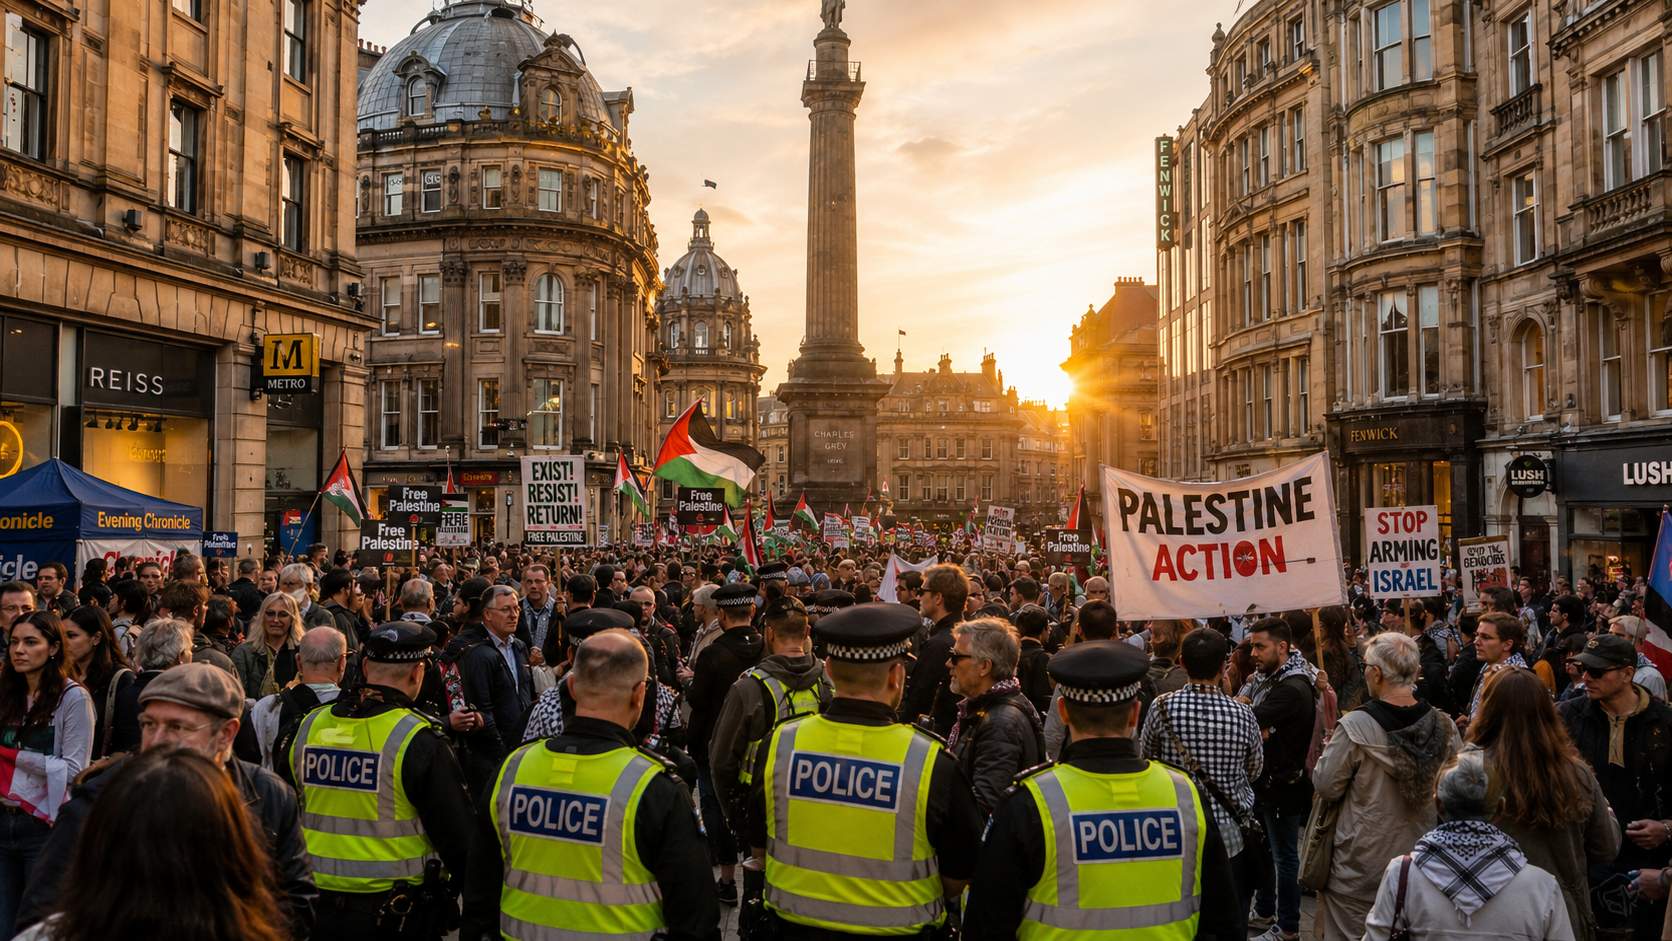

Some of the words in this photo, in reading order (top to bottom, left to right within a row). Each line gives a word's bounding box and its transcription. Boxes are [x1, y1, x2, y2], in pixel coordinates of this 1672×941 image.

[1159, 140, 1171, 242] FENWICK
[270, 339, 304, 370] M
[90, 366, 164, 395] REISS
[267, 378, 306, 389] METRO
[1351, 427, 1398, 442] FENWICK
[532, 461, 573, 481] EXIST!
[1511, 469, 1545, 480] LUSH
[1623, 460, 1672, 486] LUSH
[402, 487, 428, 500] Free
[528, 483, 578, 503] RESIST!
[690, 489, 712, 501] Free
[389, 499, 440, 513] Palestine
[527, 504, 583, 525] RETURN!
[679, 500, 723, 512] Palestine
[1118, 476, 1315, 536] PALESTINE
[97, 511, 143, 532] Evening
[144, 512, 191, 529] Chronicle
[378, 523, 405, 536] Free
[1377, 510, 1428, 535] STOP
[361, 536, 420, 550] Palestine
[527, 531, 545, 542] FREE
[546, 531, 584, 543] PALESTINE
[1152, 535, 1287, 582] ACTION
[1369, 538, 1438, 563] ARMING
[1373, 567, 1438, 593] ISRAEL
[306, 753, 375, 785] POLICE
[795, 759, 894, 802] POLICE
[513, 793, 601, 836] POLICE
[1080, 817, 1178, 854] POLICE
